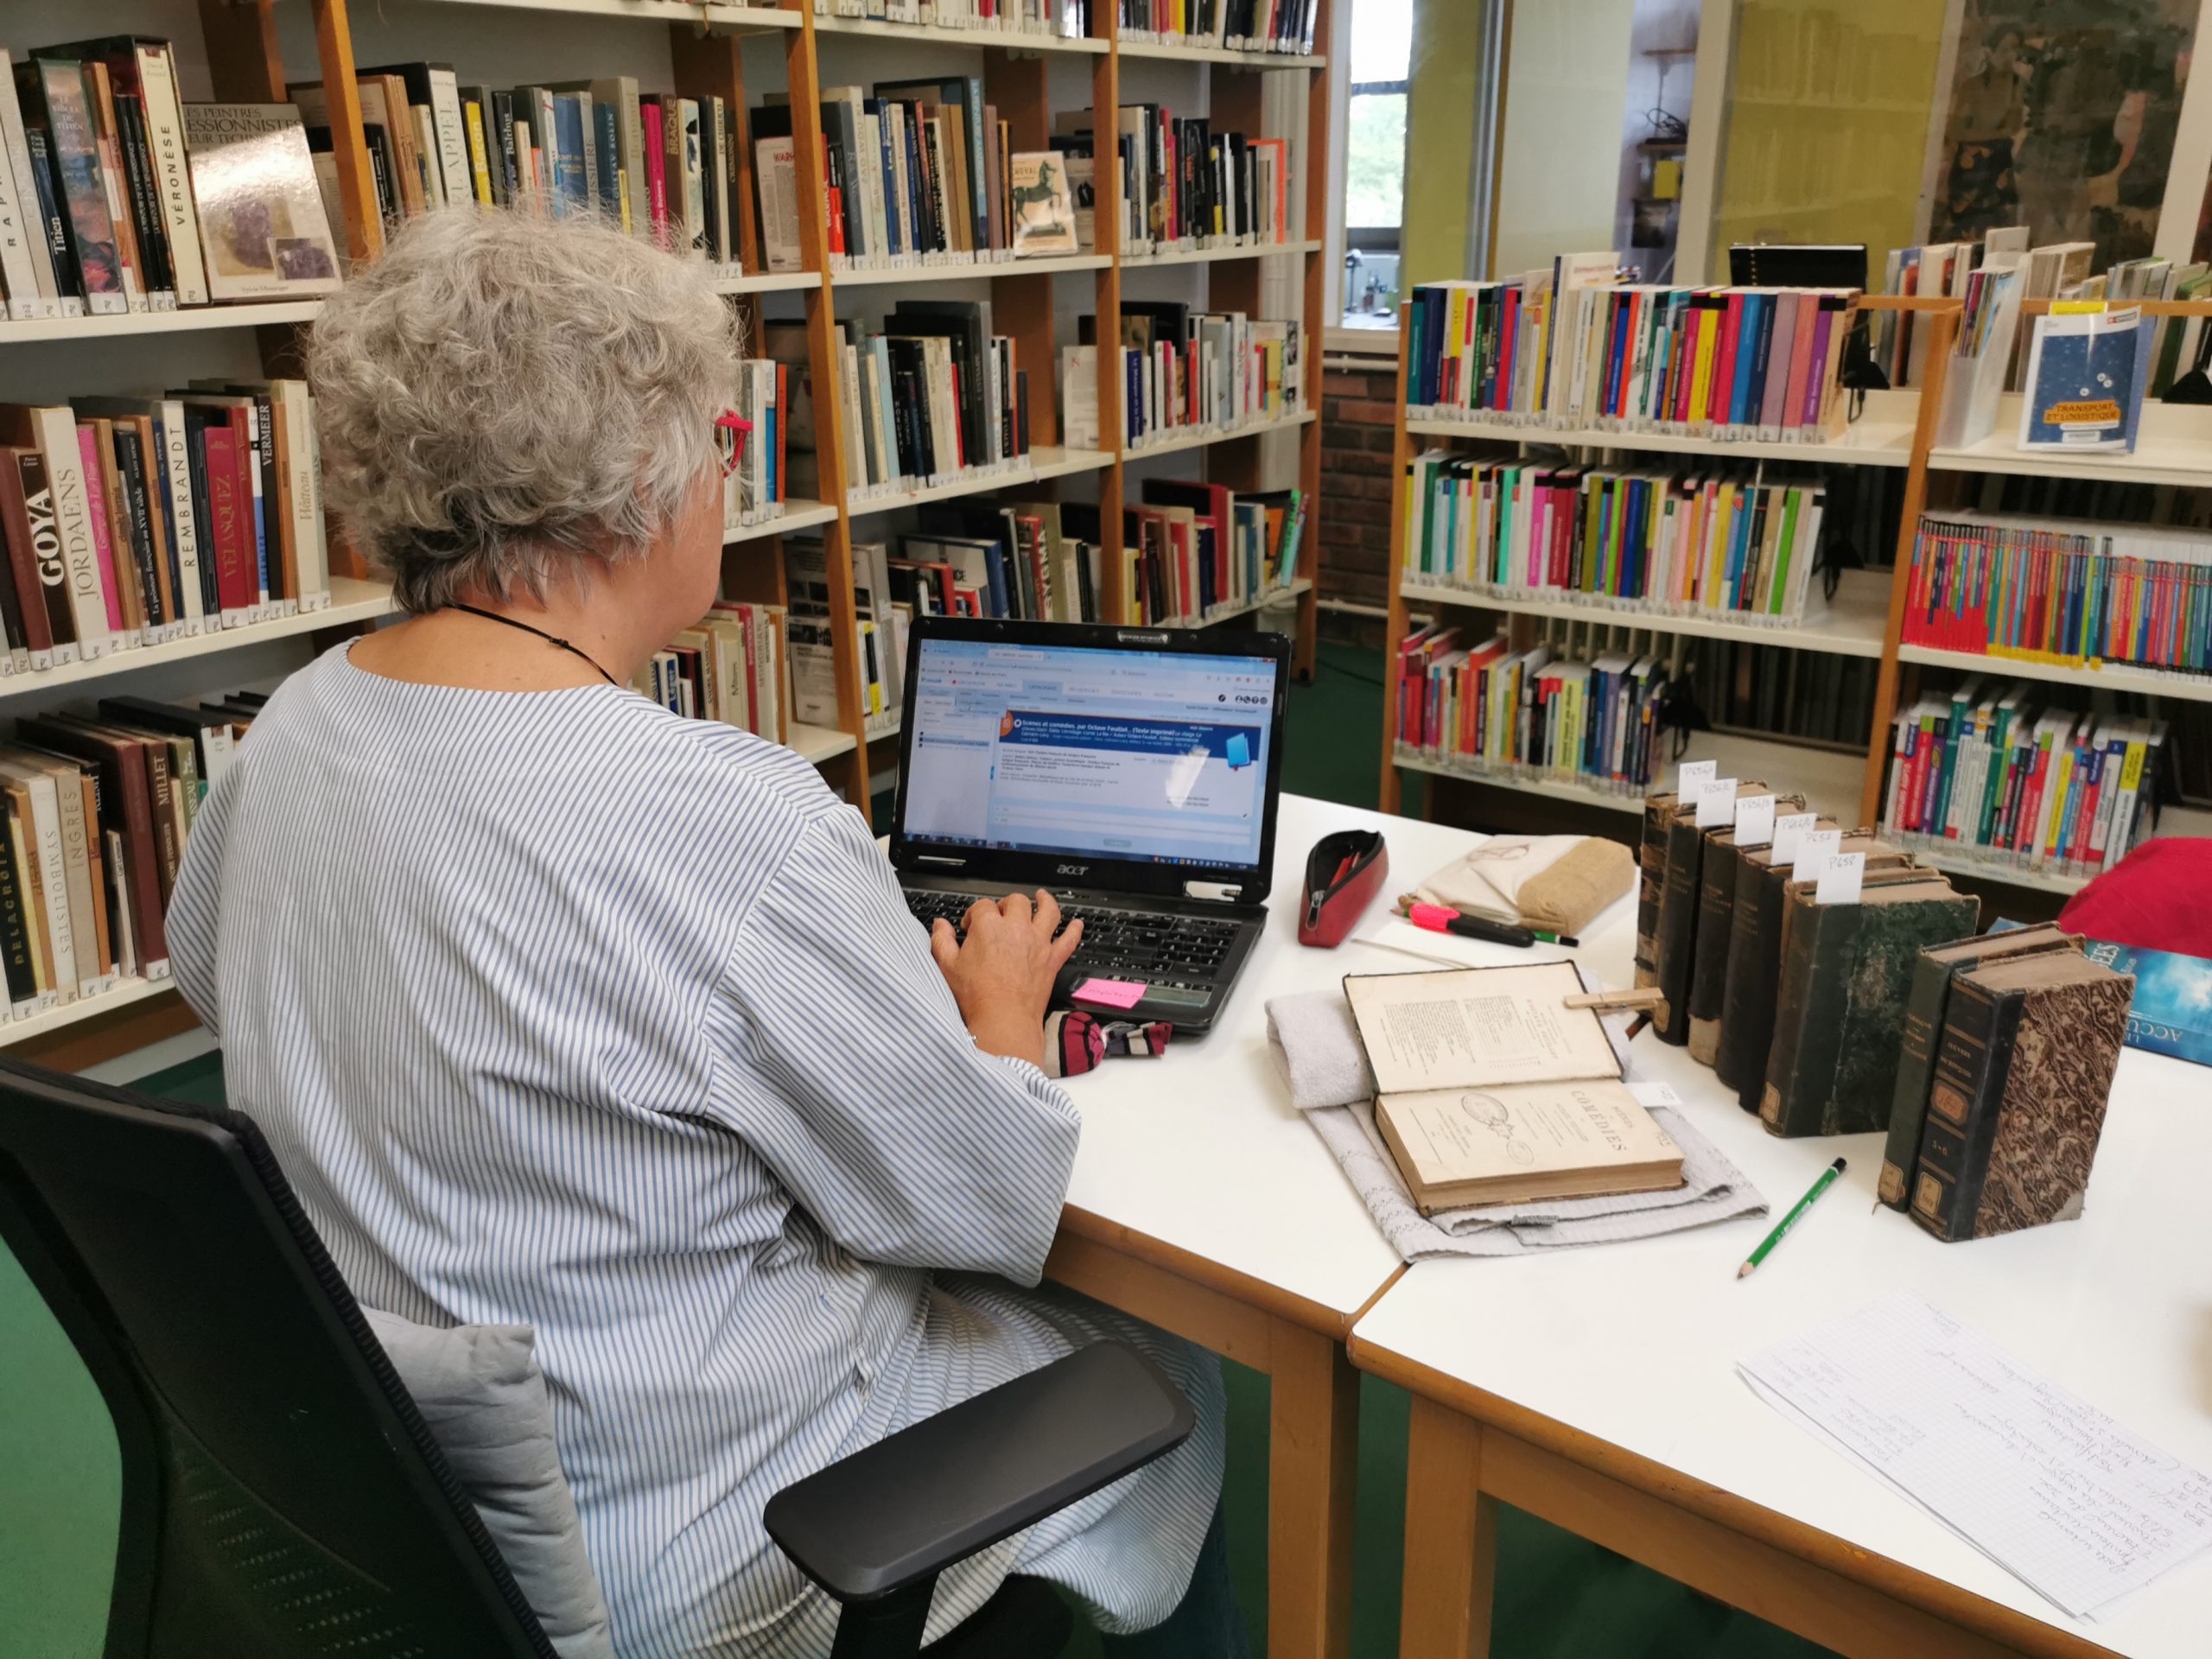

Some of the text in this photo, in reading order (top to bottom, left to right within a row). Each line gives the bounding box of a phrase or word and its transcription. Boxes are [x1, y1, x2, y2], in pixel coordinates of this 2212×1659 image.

[187, 107, 261, 118] ES PEINTRES
[188, 118, 303, 131] ESSIONNISTES
[189, 134, 216, 144] EUR
[505, 113, 515, 155] Balthus
[667, 99, 679, 156] BRAQUE
[474, 121, 486, 172] Bacon
[161, 125, 186, 226] VÉRONÈSE
[51, 217, 67, 254] Titien
[262, 404, 274, 467] VERMEER
[169, 428, 196, 567] REMBRANDT
[26, 487, 64, 587] GOYA
[57, 468, 99, 602] JORDAENS
[216, 474, 238, 581] VELASQUEZ
[154, 756, 171, 806] MILLET
[66, 791, 85, 869] INGRES
[46, 831, 72, 954] SYMBOLISTES
[1057, 864, 1089, 876] acer
[2126, 1020, 2183, 1043] ACCU
[1571, 1090, 1628, 1152] COMÉDIES
